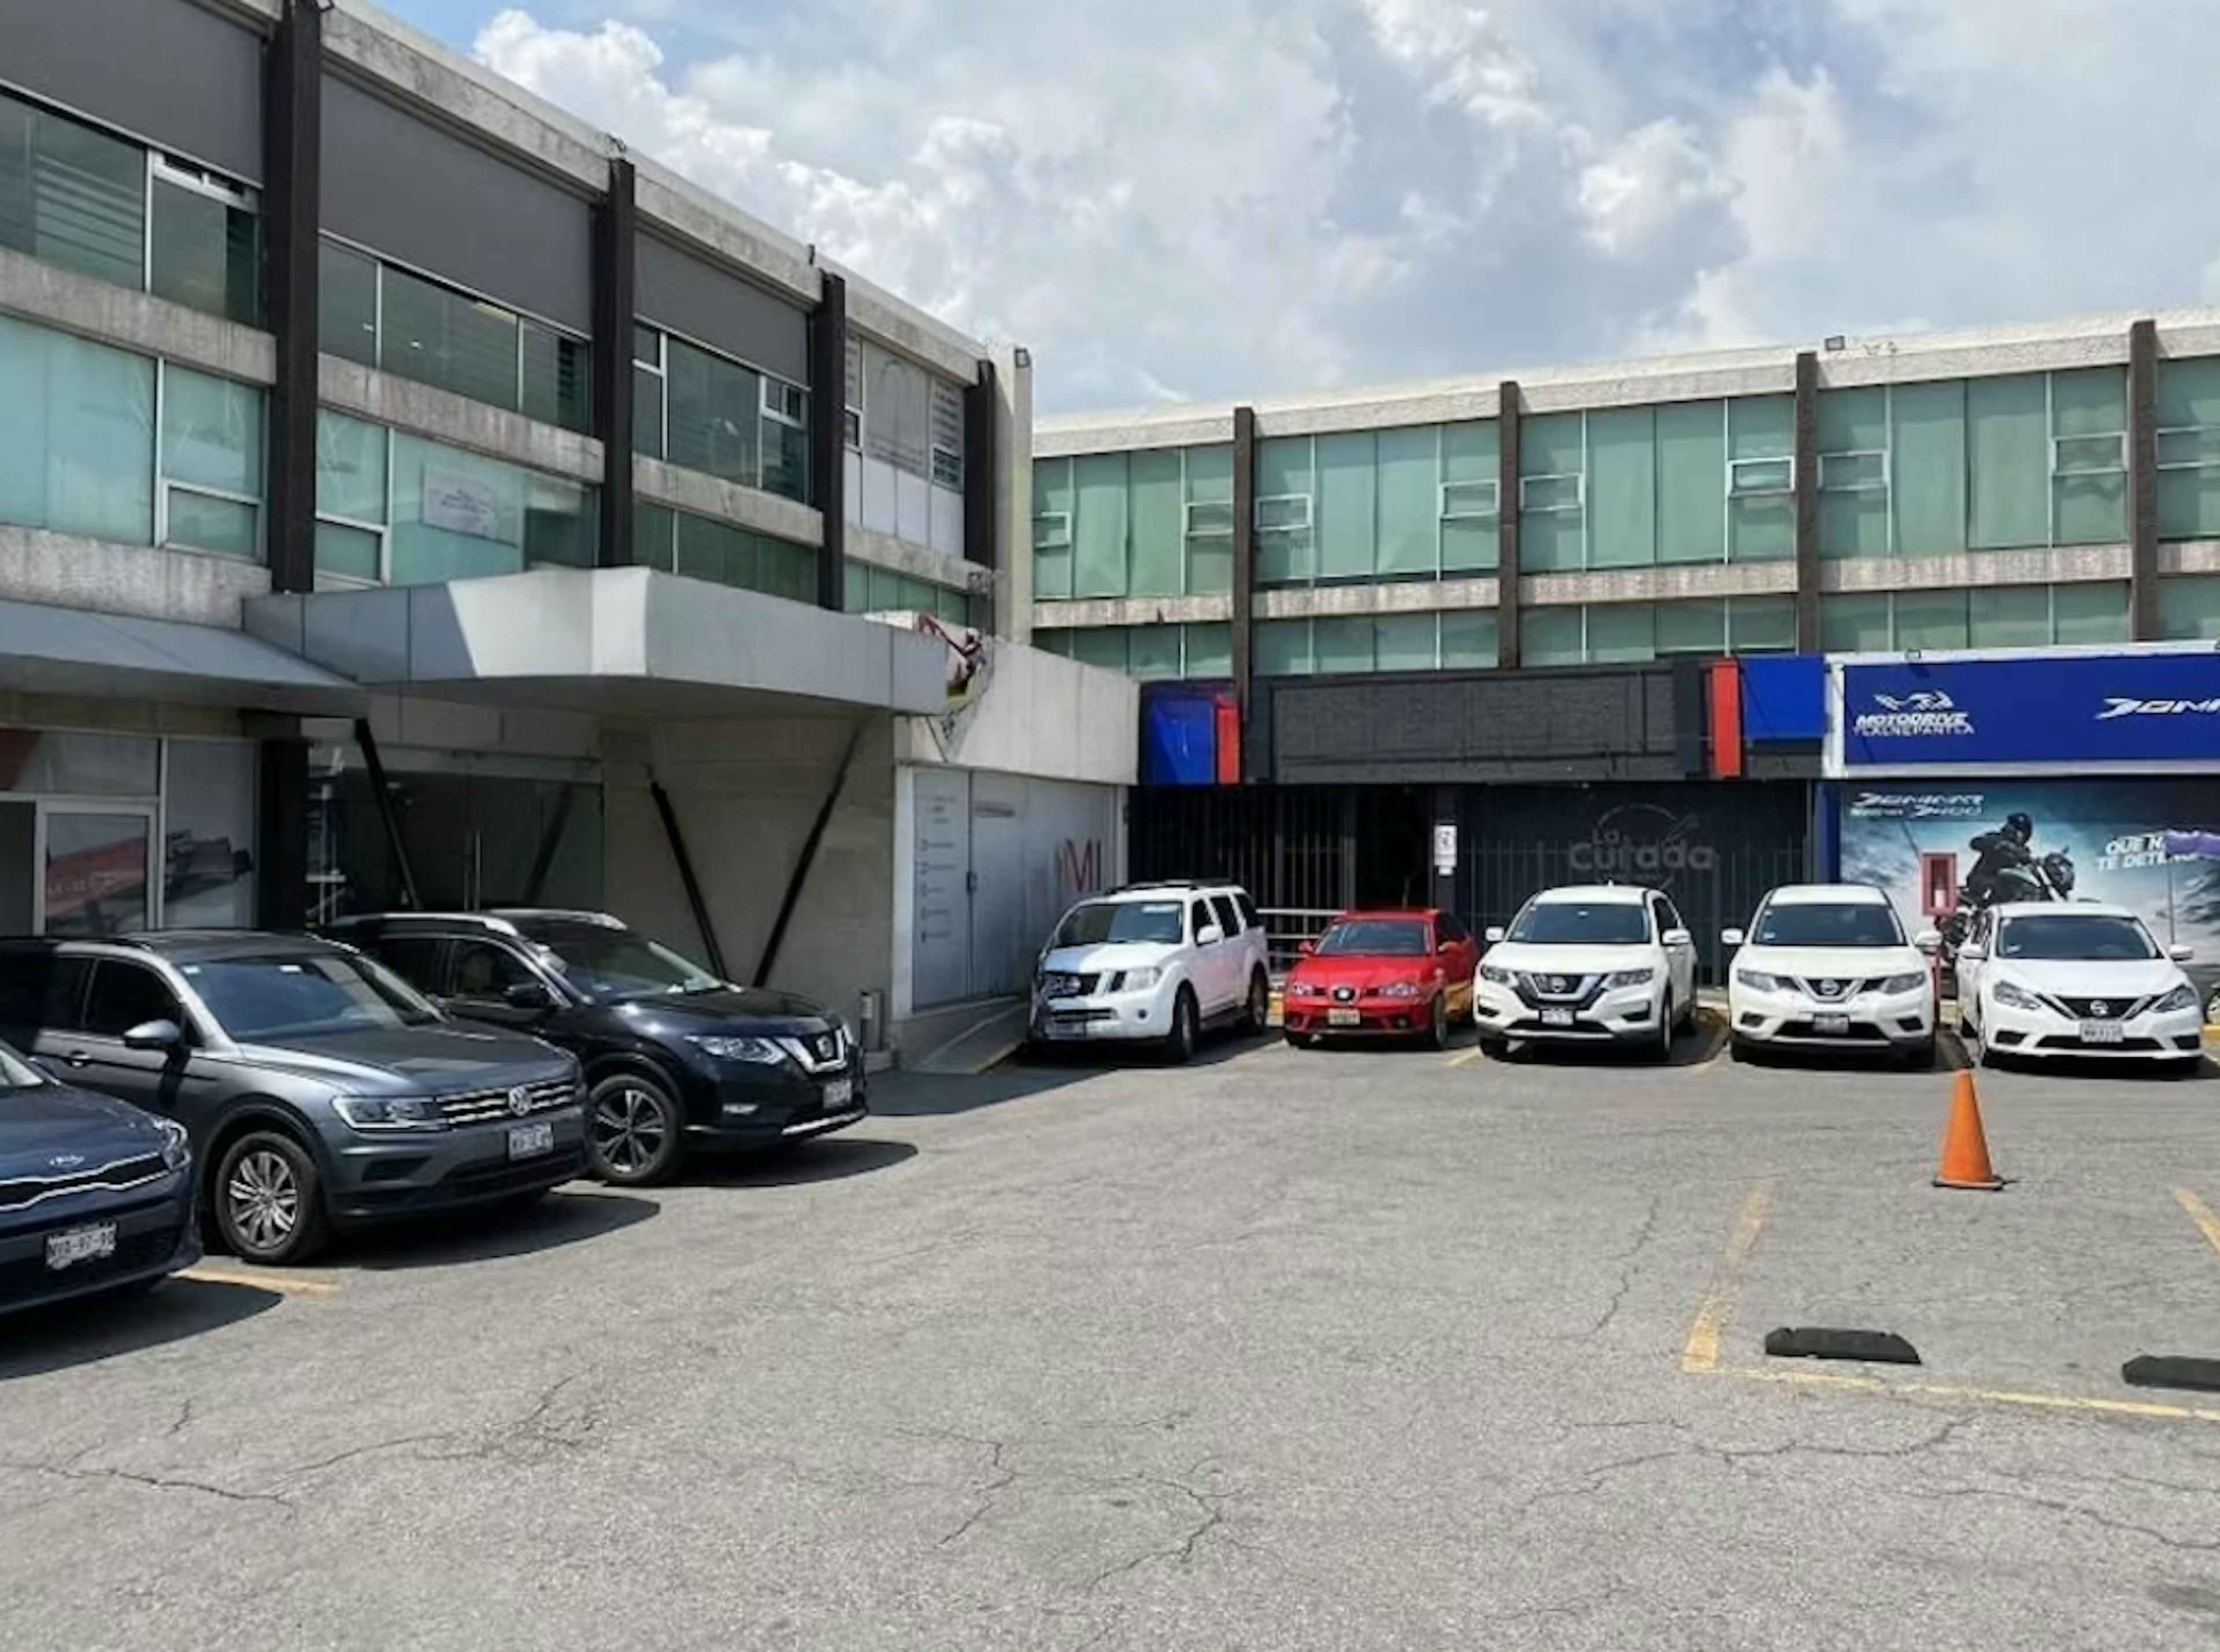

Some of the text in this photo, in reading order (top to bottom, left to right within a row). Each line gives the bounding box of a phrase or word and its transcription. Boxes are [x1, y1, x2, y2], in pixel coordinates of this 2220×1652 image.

[1855, 712, 1969, 727] MOTODRIVE
[2106, 836, 2145, 855] QUE
[2098, 856, 2118, 871] TE
